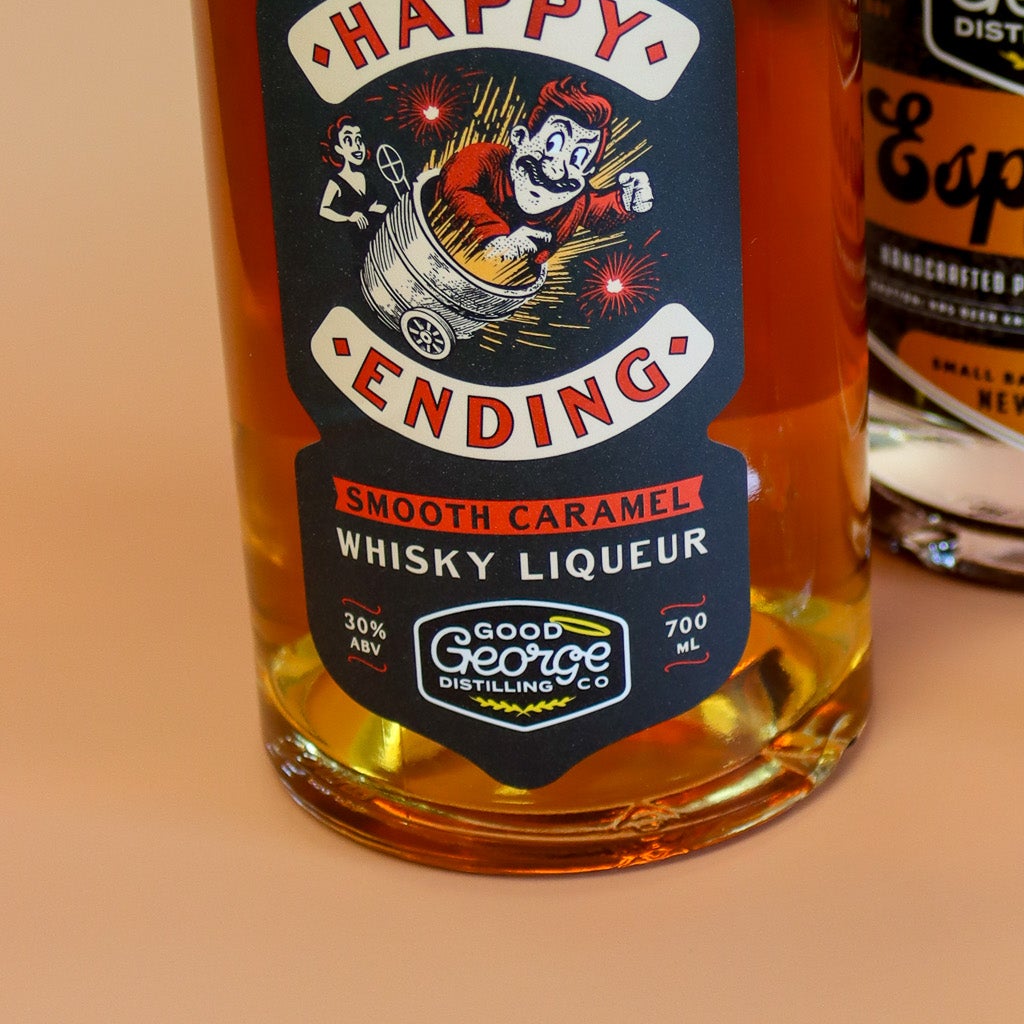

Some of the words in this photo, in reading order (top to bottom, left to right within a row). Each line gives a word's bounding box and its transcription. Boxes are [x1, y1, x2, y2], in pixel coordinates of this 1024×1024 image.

[352, 345, 670, 450] ENDING
[346, 485, 491, 531] SMOOTH
[508, 485, 691, 531] CARAMEL
[335, 526, 496, 581] WHISKY
[519, 526, 709, 582] LIQUEUR
[344, 611, 387, 641] 30%
[474, 621, 564, 641] GOOD
[664, 611, 708, 639] 700
[349, 636, 382, 657] ABV
[430, 626, 612, 686] George
[676, 636, 701, 655] ML
[438, 675, 554, 694] DISTILLING
[576, 675, 610, 691] CO
